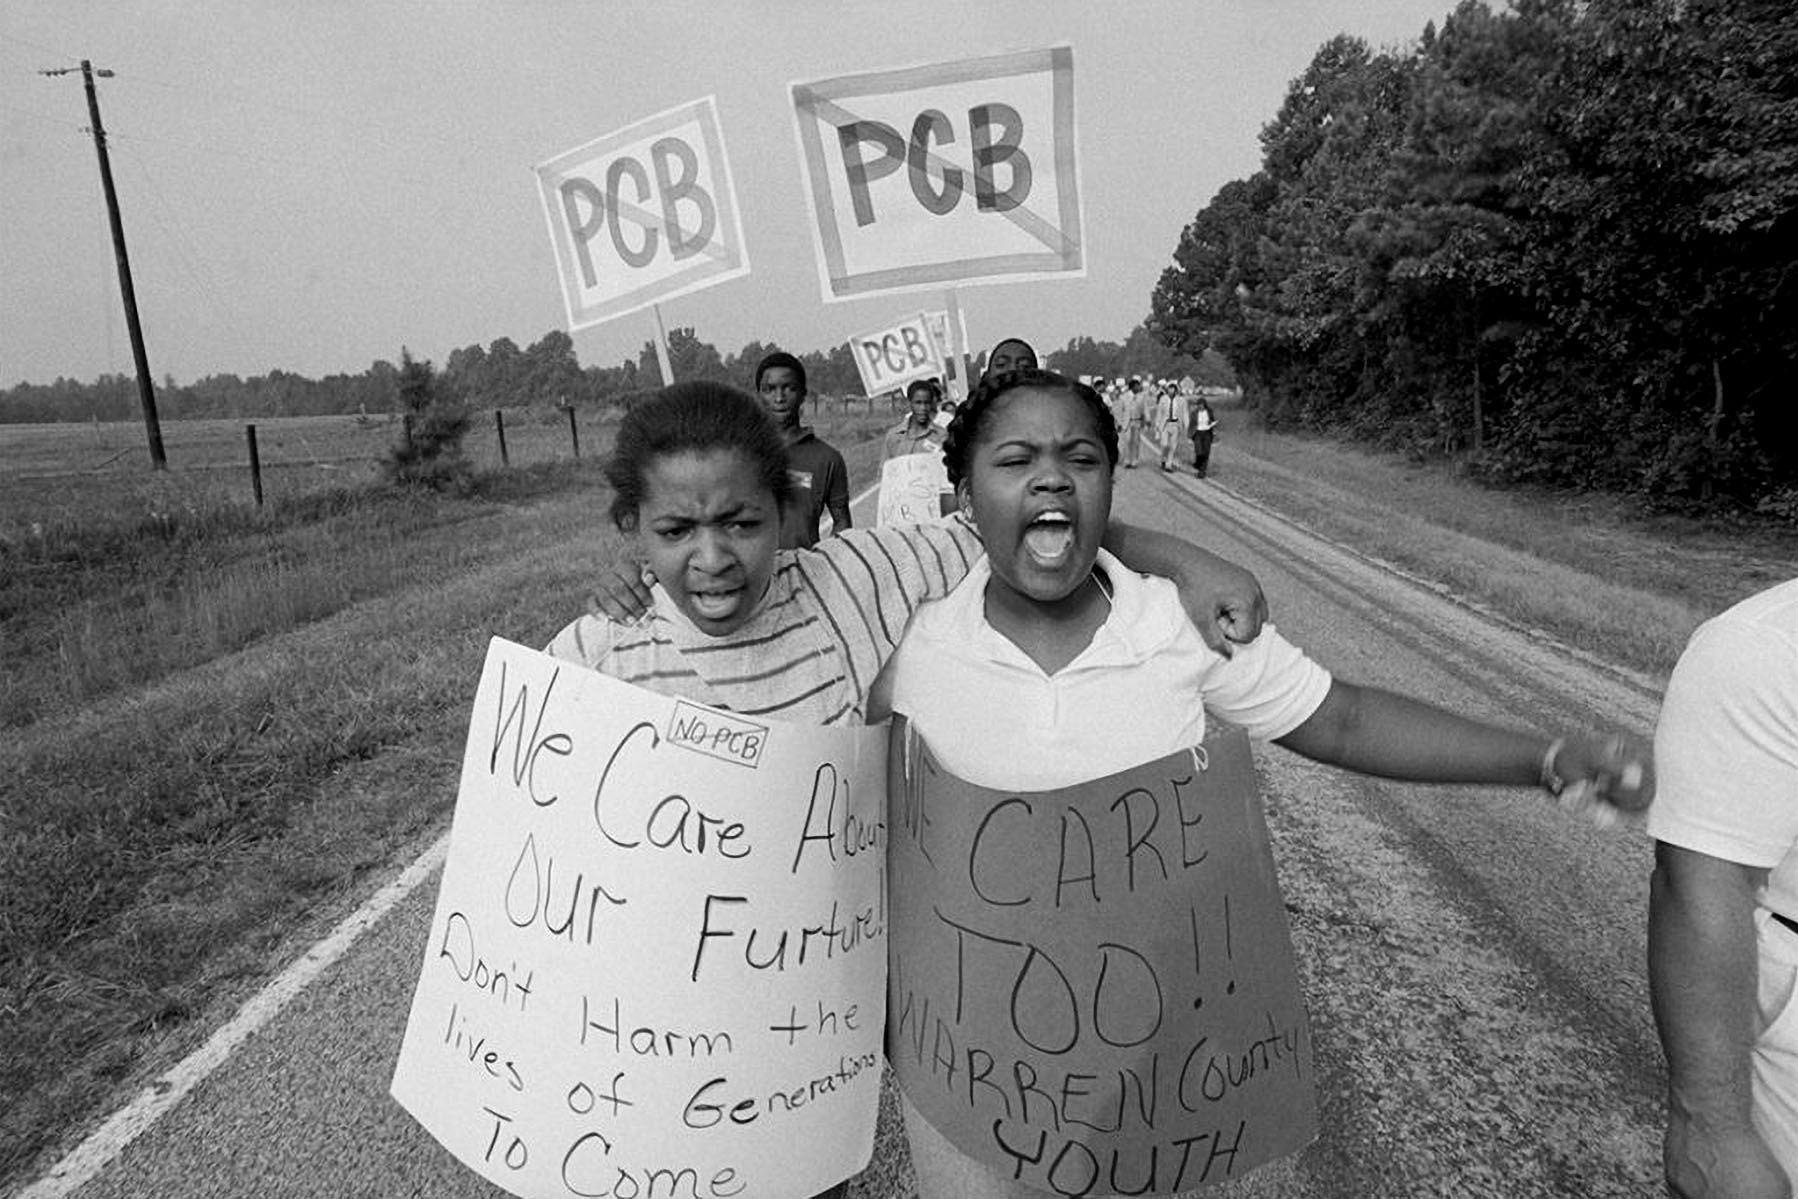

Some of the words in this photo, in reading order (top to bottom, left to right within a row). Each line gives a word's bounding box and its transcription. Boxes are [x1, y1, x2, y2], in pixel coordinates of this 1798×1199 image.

[559, 136, 717, 290] PCB
[837, 101, 1033, 227] PCB
[862, 326, 928, 381] PCB
[491, 661, 573, 807] We
[594, 721, 752, 860] Care
[675, 716, 707, 744] NO
[712, 727, 760, 760] PCB
[505, 832, 627, 945] Our
[969, 776, 1208, 908] CARE
[439, 911, 534, 1010] Don't
[581, 995, 732, 1056] Harm
[769, 1001, 861, 1045] the
[444, 1002, 525, 1092] lives
[567, 1072, 634, 1117] of
[683, 1053, 877, 1129] Generations
[899, 991, 1159, 1134] WARREN
[1178, 1009, 1301, 1114] County
[482, 1105, 528, 1171] To
[561, 1131, 747, 1199] Come
[992, 1120, 1246, 1199] YOUTH
